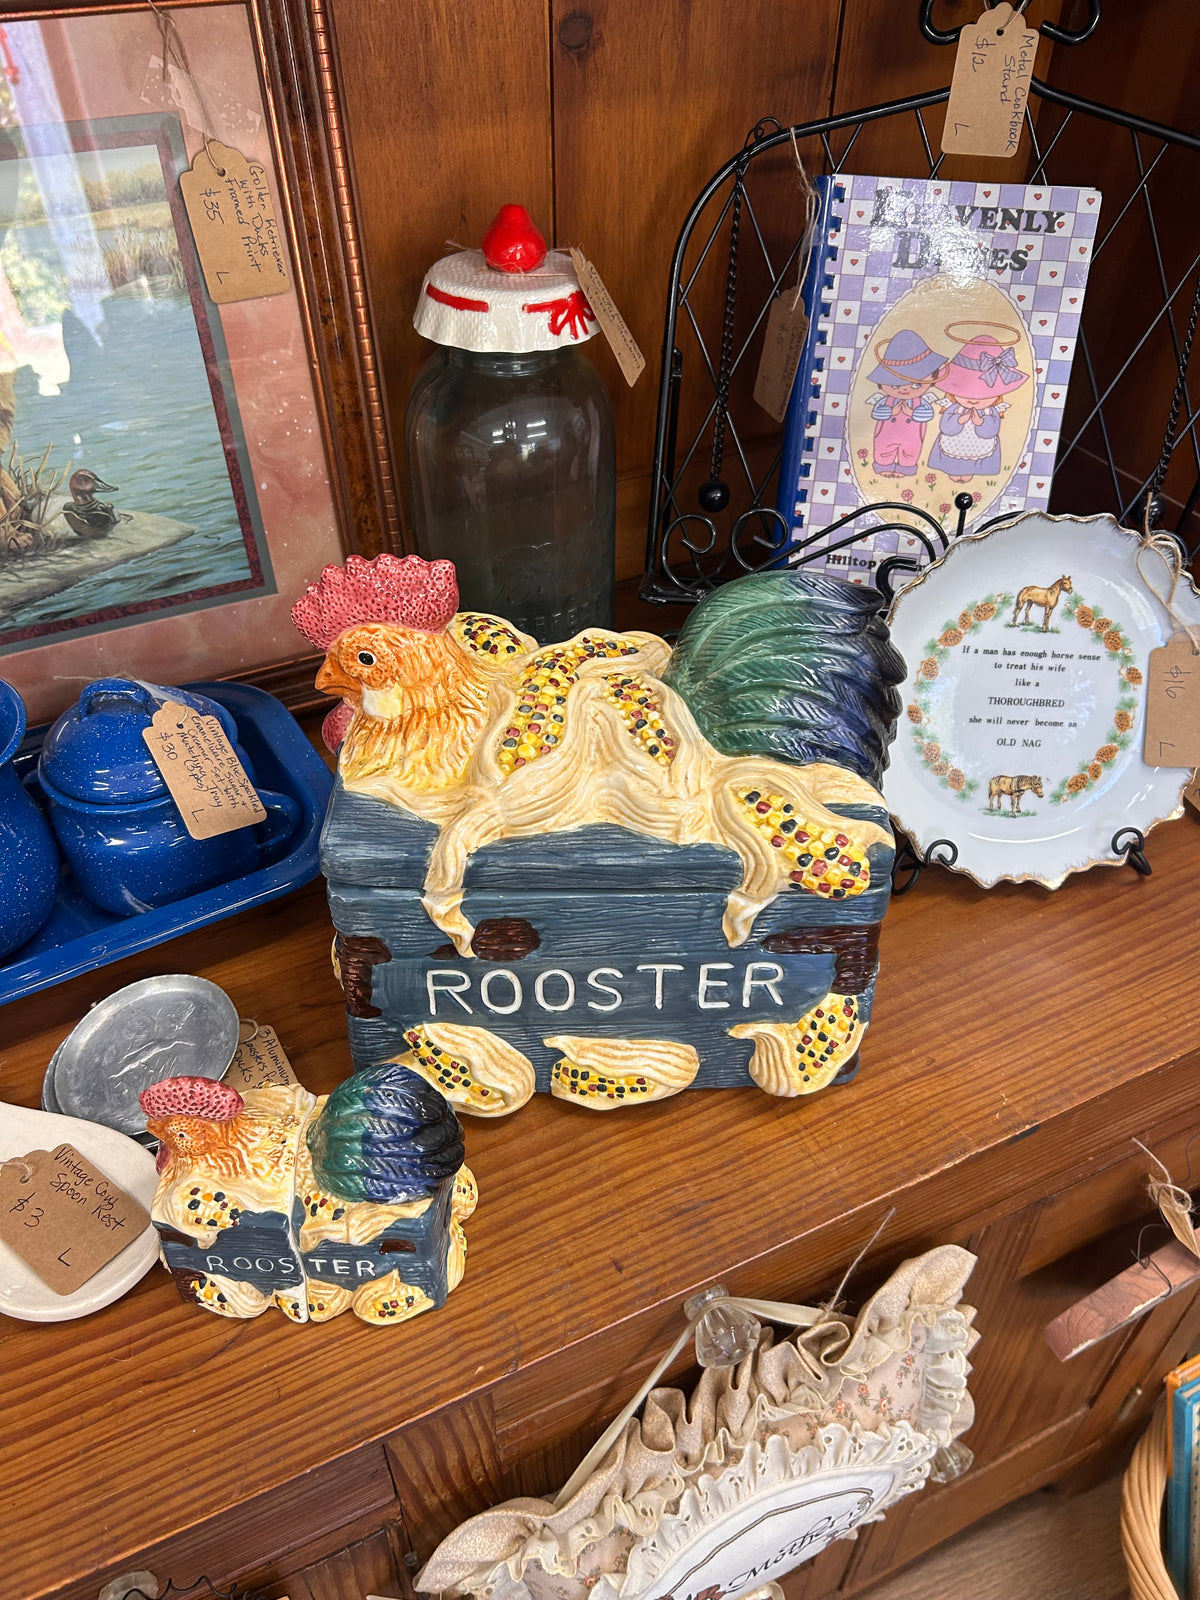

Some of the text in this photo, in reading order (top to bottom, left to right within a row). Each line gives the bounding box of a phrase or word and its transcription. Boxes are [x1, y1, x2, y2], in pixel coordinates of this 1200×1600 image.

[971, 35, 996, 73] $12
[1000, 54, 1015, 106] Stand
[1005, 35, 1035, 152] Metal Cookbook
[954, 122, 970, 137] L
[199, 188, 225, 225] $35
[225, 178, 262, 273] Framed Print
[251, 213, 269, 257] Ducks
[216, 271, 229, 285] L
[826, 554, 877, 569] Hilltop
[962, 645, 971, 654] If
[1003, 648, 1016, 656] has
[1020, 650, 1048, 659] enough
[1052, 650, 1074, 660] horse
[994, 661, 1066, 673] to treat his wife
[1015, 678, 1031, 687] like
[1163, 665, 1192, 699] $16
[988, 696, 1065, 708] THOROUGHBRED
[969, 716, 982, 724] she
[986, 716, 1002, 725] will
[1007, 718, 1029, 726] never
[1035, 718, 1064, 728] become
[156, 731, 178, 761] $30
[187, 728, 214, 765] Creamer
[210, 766, 225, 785] Set
[996, 737, 1042, 748] OLD NAG
[1160, 741, 1175, 758] L
[176, 731, 223, 808] Matching Tray
[205, 718, 264, 814] Vintage Blue Speckled
[224, 771, 243, 797] Sugar
[192, 808, 204, 823] L
[425, 961, 785, 1016] ROOSTER
[258, 1028, 271, 1038] 3
[54, 1146, 118, 1206] Vintage Cow
[50, 1172, 125, 1231] Spoon Rest
[57, 1247, 72, 1267] L
